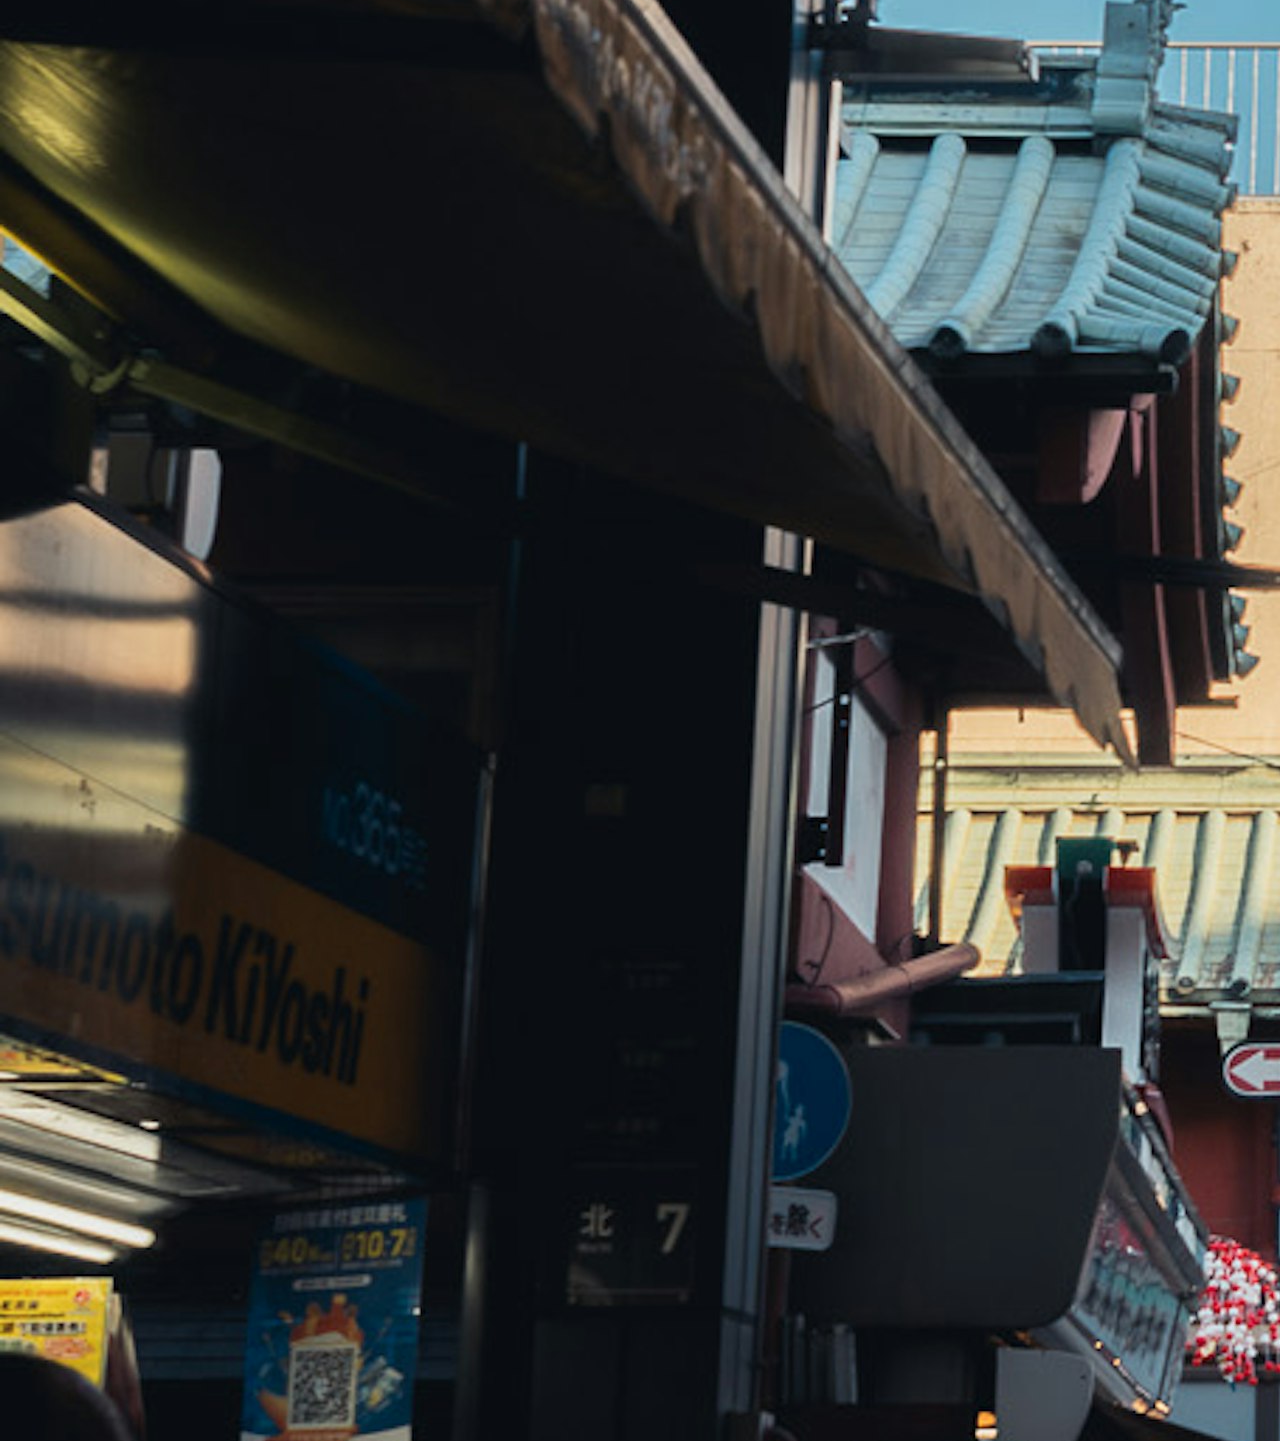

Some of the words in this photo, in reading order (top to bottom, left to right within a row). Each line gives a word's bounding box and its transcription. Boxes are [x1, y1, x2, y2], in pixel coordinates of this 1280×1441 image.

[205, 914, 372, 1087] KiYoshi
[579, 1202, 617, 1238] 北
[656, 1202, 692, 1255] 7
